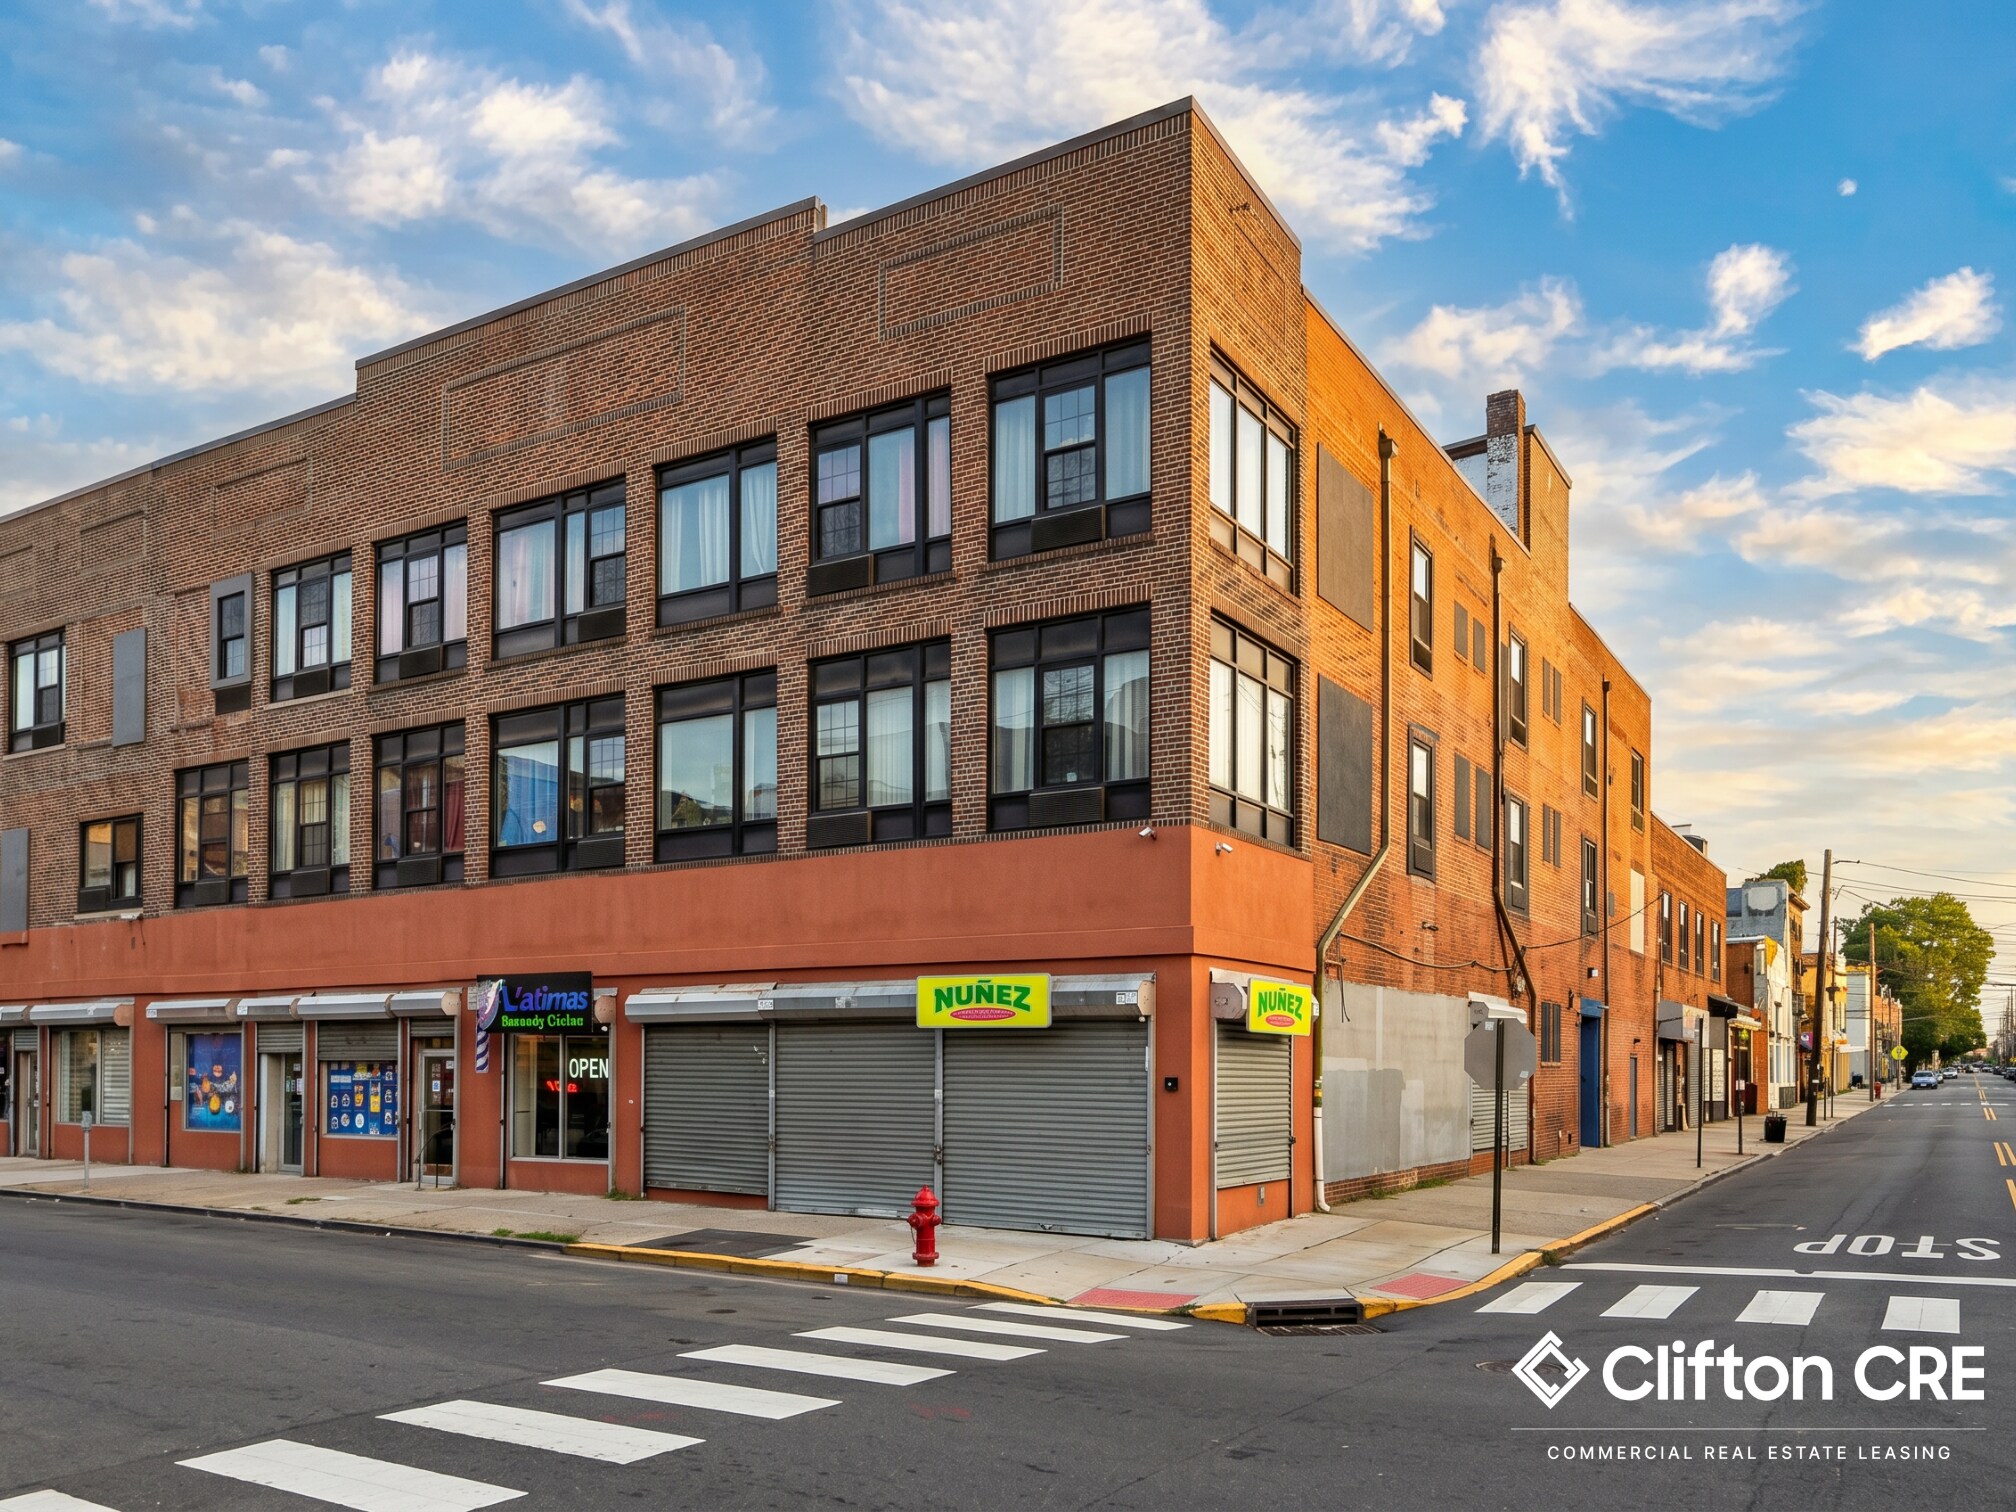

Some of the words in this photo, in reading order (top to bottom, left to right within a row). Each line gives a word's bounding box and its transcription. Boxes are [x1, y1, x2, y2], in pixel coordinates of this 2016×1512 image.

[934, 979, 1031, 1013] NUÑEZ
[1257, 987, 1303, 1021] NUÑEZ
[569, 1058, 609, 1079] OPEN
[1793, 1234, 2001, 1261] STOP
